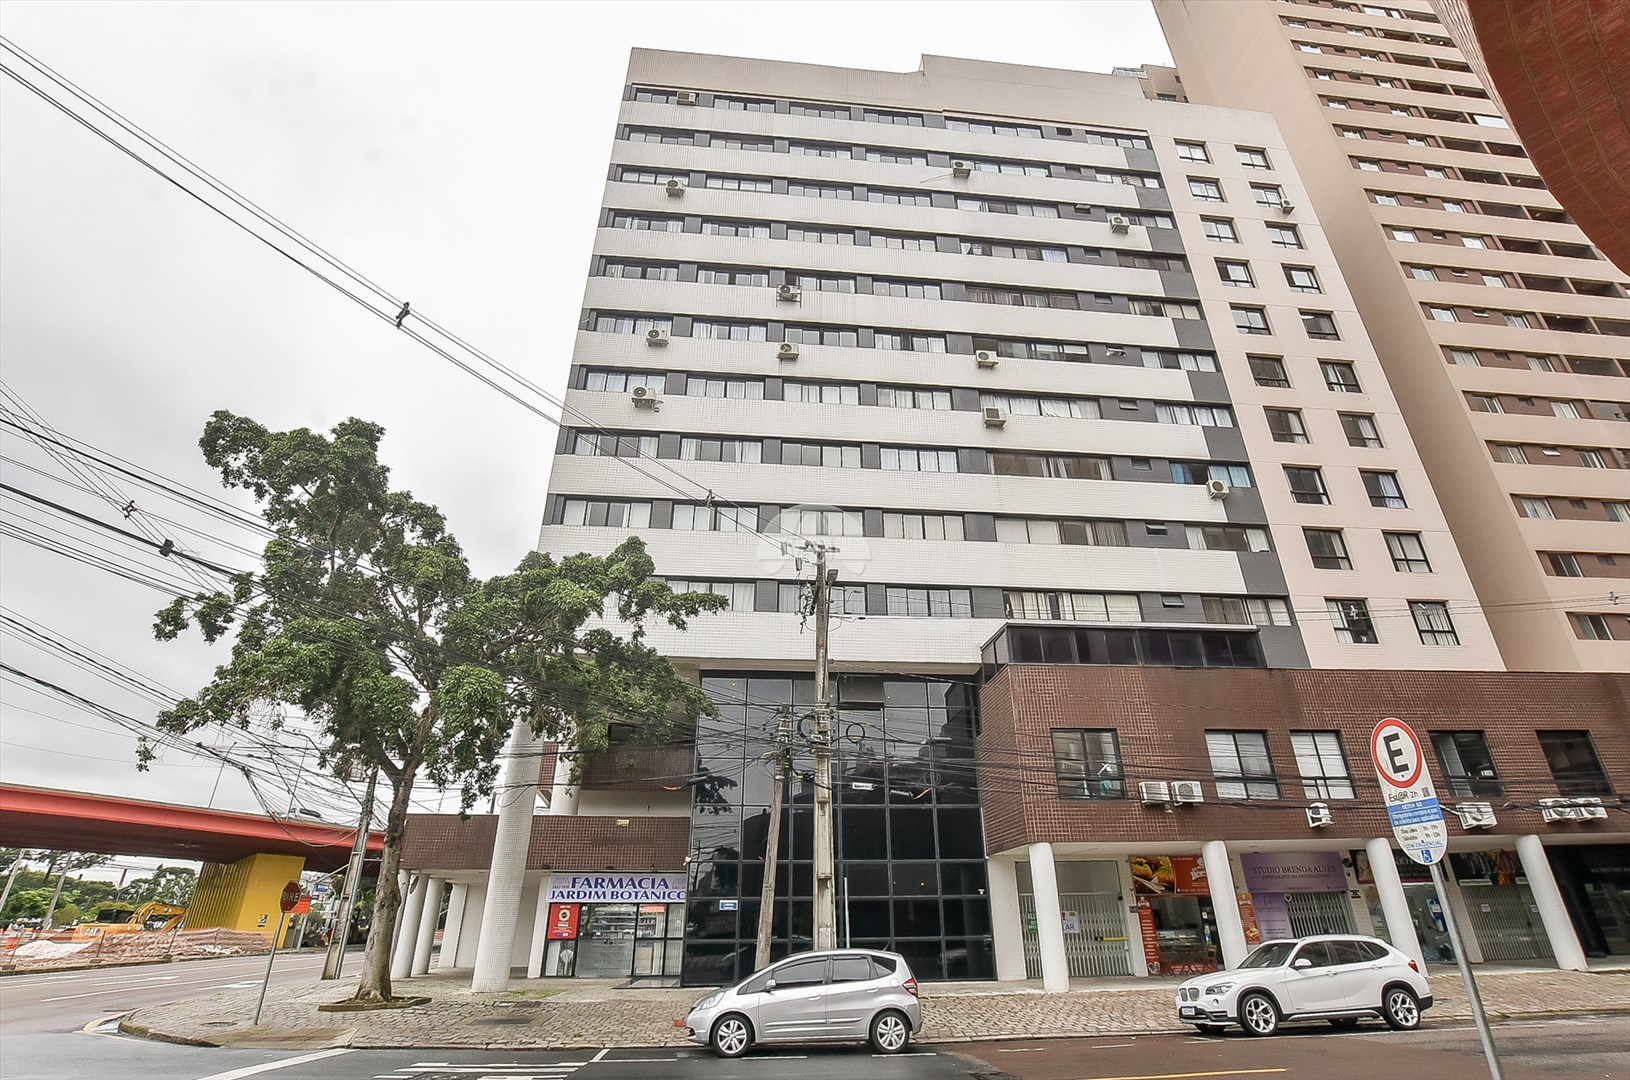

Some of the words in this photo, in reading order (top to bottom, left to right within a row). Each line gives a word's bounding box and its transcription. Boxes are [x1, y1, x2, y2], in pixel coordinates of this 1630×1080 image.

[1383, 732, 1410, 774] E
[1252, 866, 1281, 874] STUDIO
[1281, 865, 1313, 874] BRENDA
[1313, 865, 1337, 873] ALVES
[550, 890, 607, 900] JARDIM
[84, 928, 100, 936] CAT
